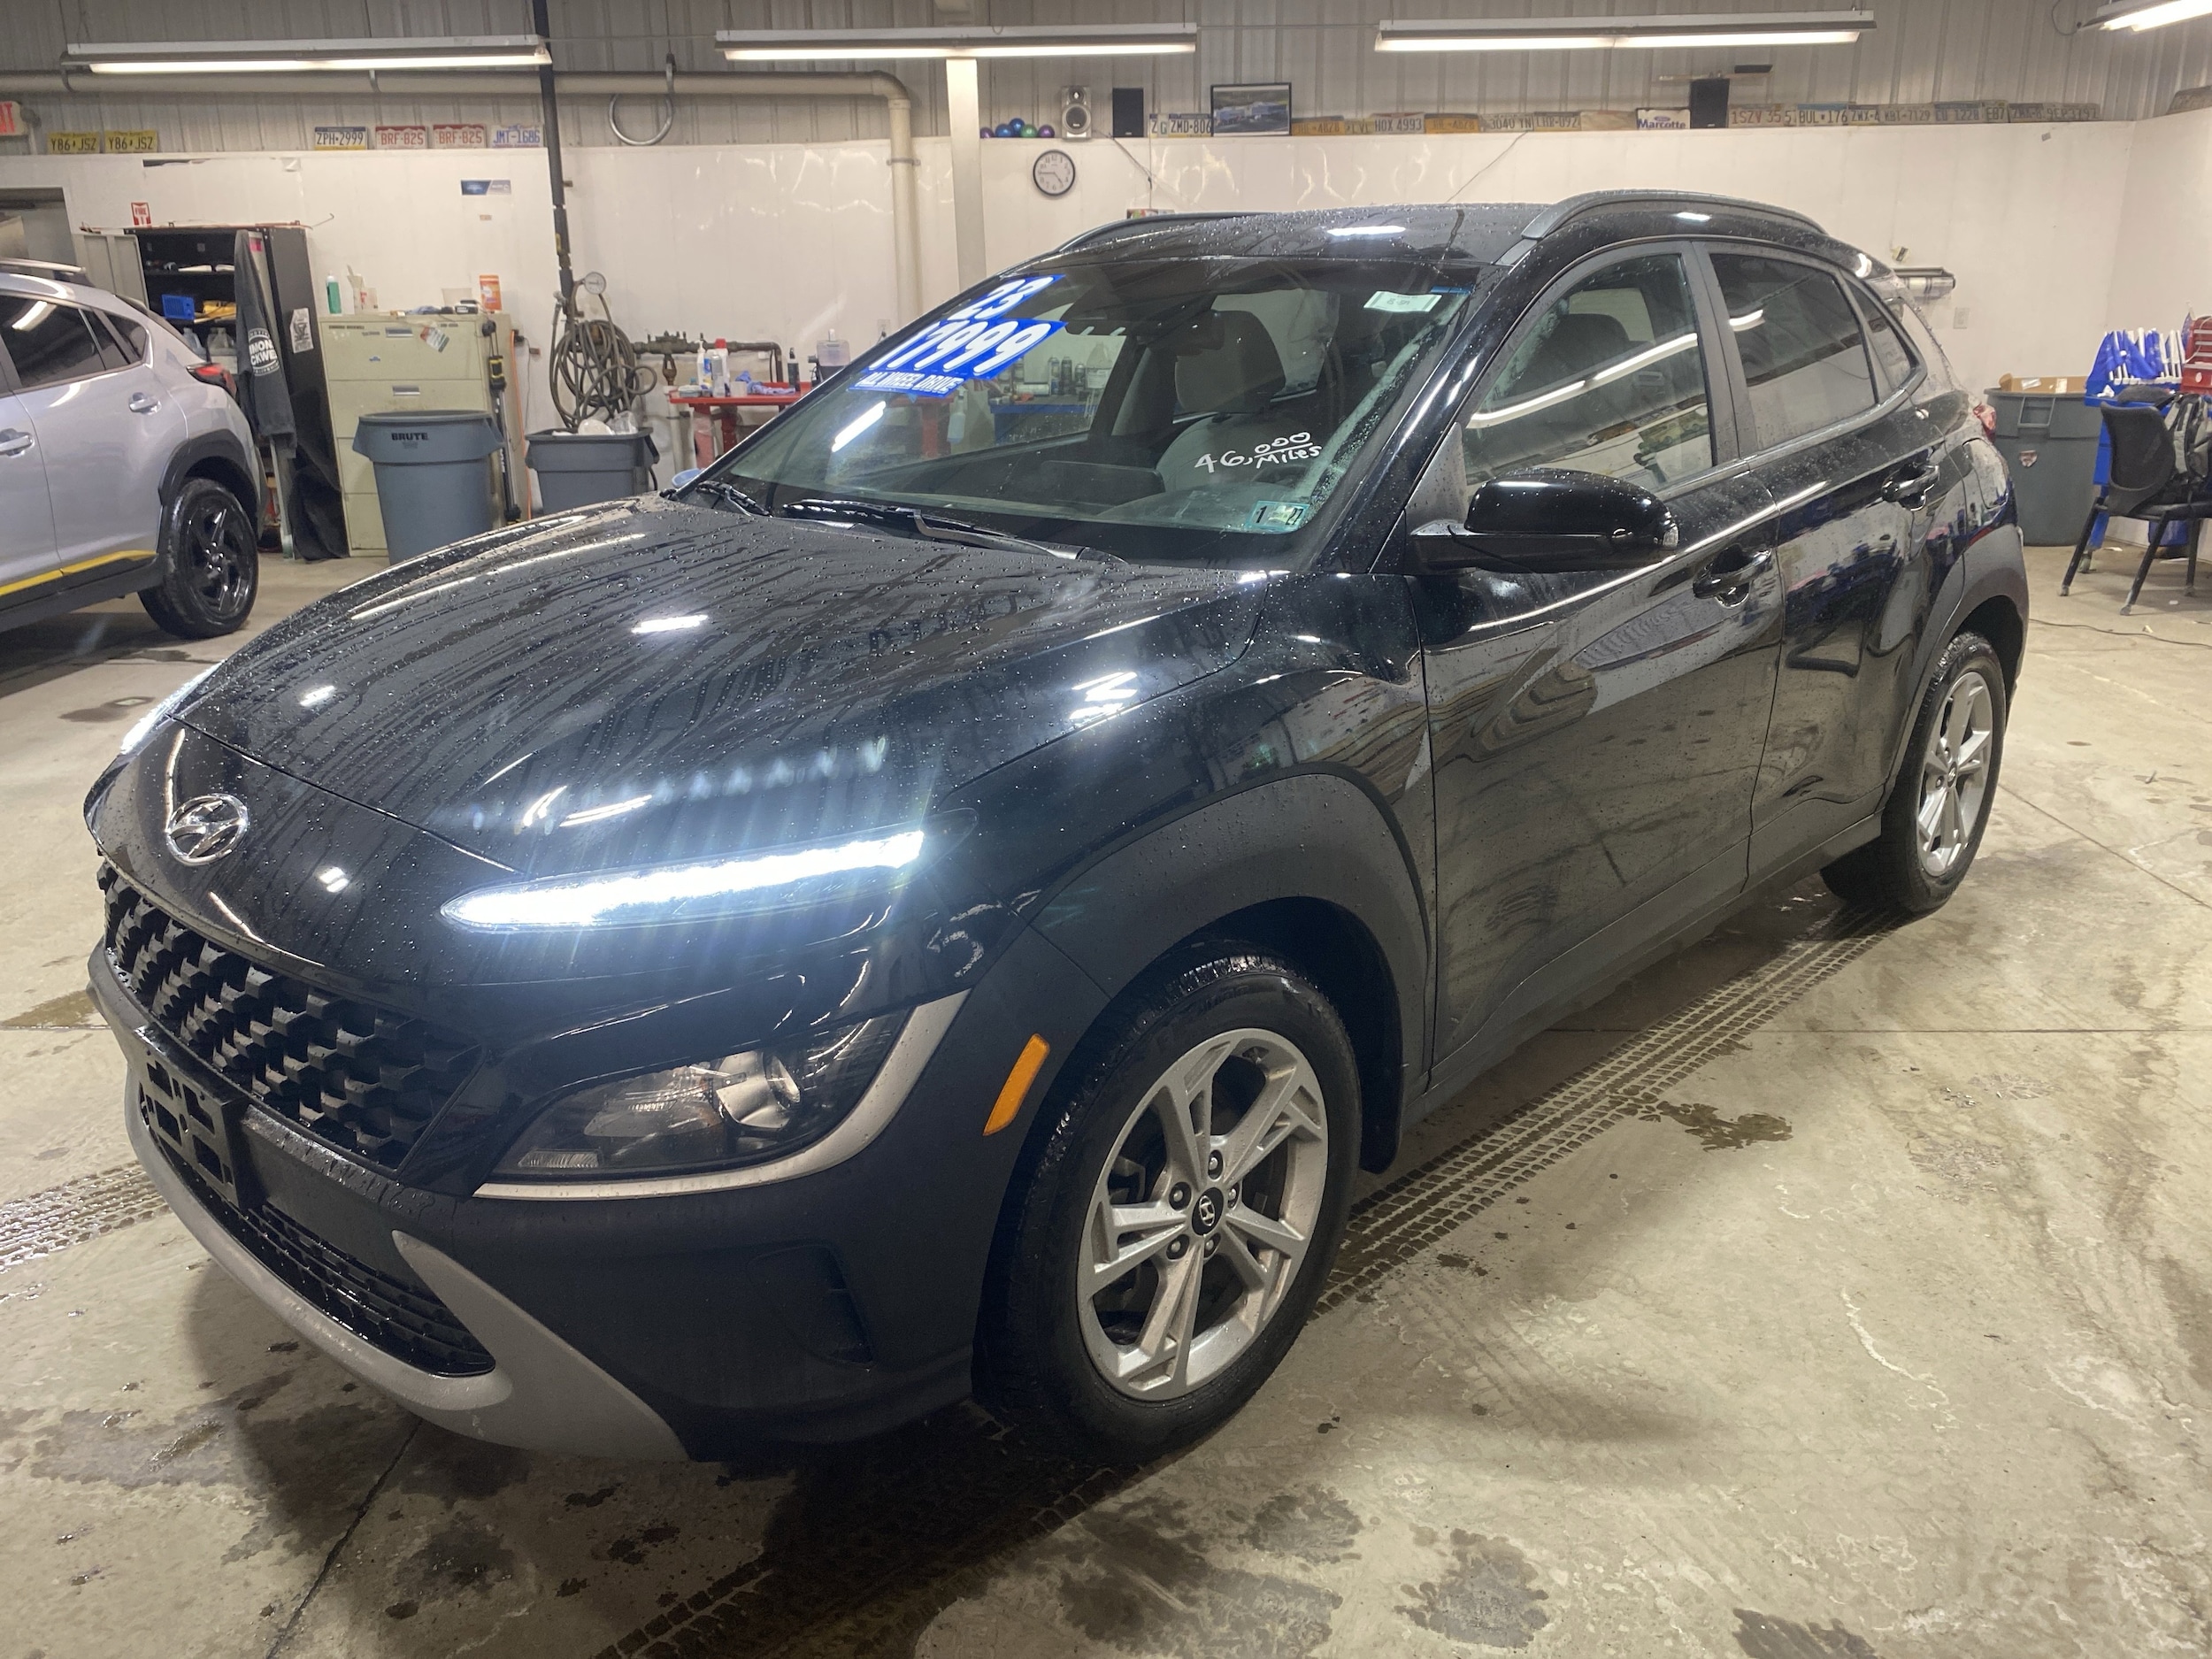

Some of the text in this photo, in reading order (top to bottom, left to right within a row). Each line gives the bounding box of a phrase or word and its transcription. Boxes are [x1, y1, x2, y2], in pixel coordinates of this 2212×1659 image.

[1395, 118, 1423, 132] 4993
[1637, 118, 1686, 128] Marcotte
[947, 276, 1054, 320] 23
[854, 371, 964, 395] ALL WHEEL DRIVE
[390, 432, 429, 441] BRUTE
[1194, 432, 1311, 473] 46,000
